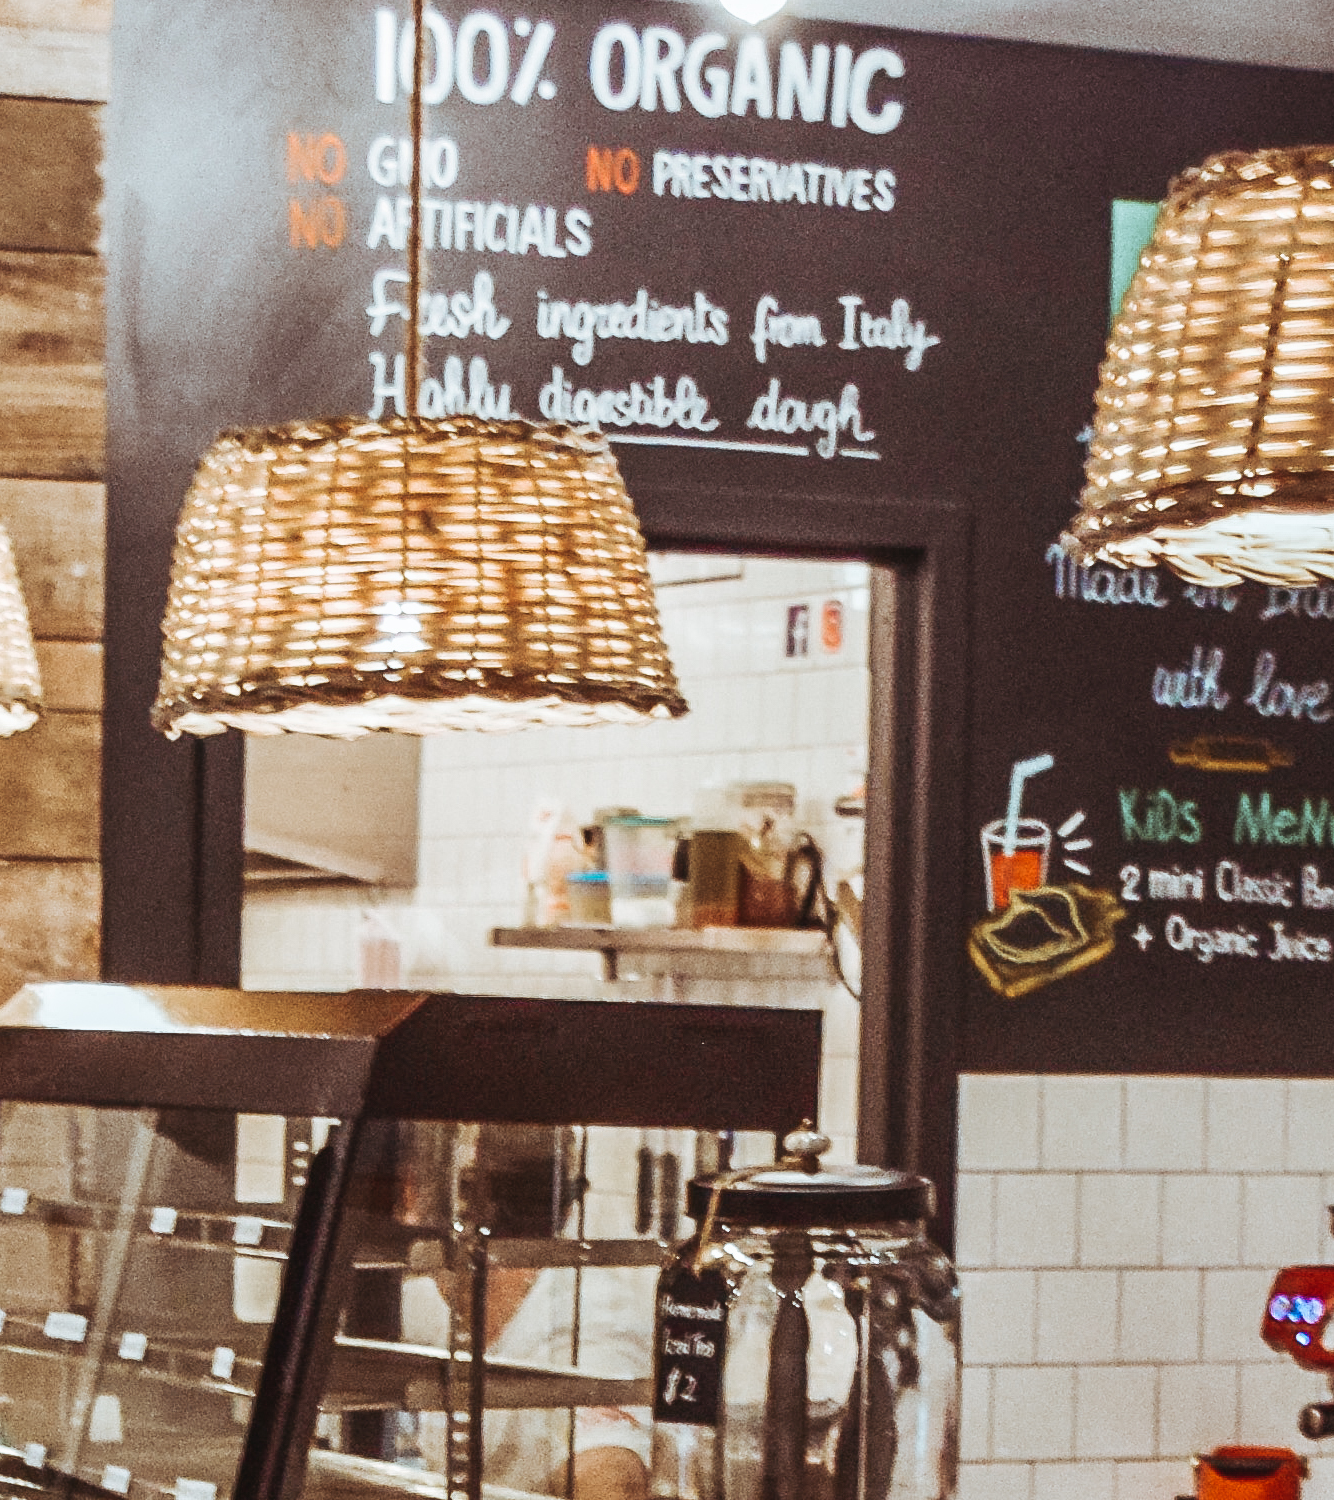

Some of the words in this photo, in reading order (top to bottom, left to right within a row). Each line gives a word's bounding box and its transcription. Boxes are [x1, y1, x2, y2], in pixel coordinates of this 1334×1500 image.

[374, 9, 558, 105] 100%
[589, 22, 907, 136] ORGANIC
[287, 131, 346, 185] NO
[586, 145, 640, 196] NO
[653, 150, 895, 211] PRESERVATIVES
[289, 197, 346, 248] NO
[537, 289, 730, 366] ingredients
[750, 295, 825, 360] from
[840, 296, 938, 371] Italy
[539, 366, 718, 429] digestible
[748, 378, 874, 460] dough
[1153, 646, 1229, 709] with
[1246, 651, 1334, 723] love
[1120, 865, 1142, 901] 2
[1148, 868, 1203, 901] mini
[1166, 914, 1258, 963] Organic
[1267, 921, 1334, 962] Juice
